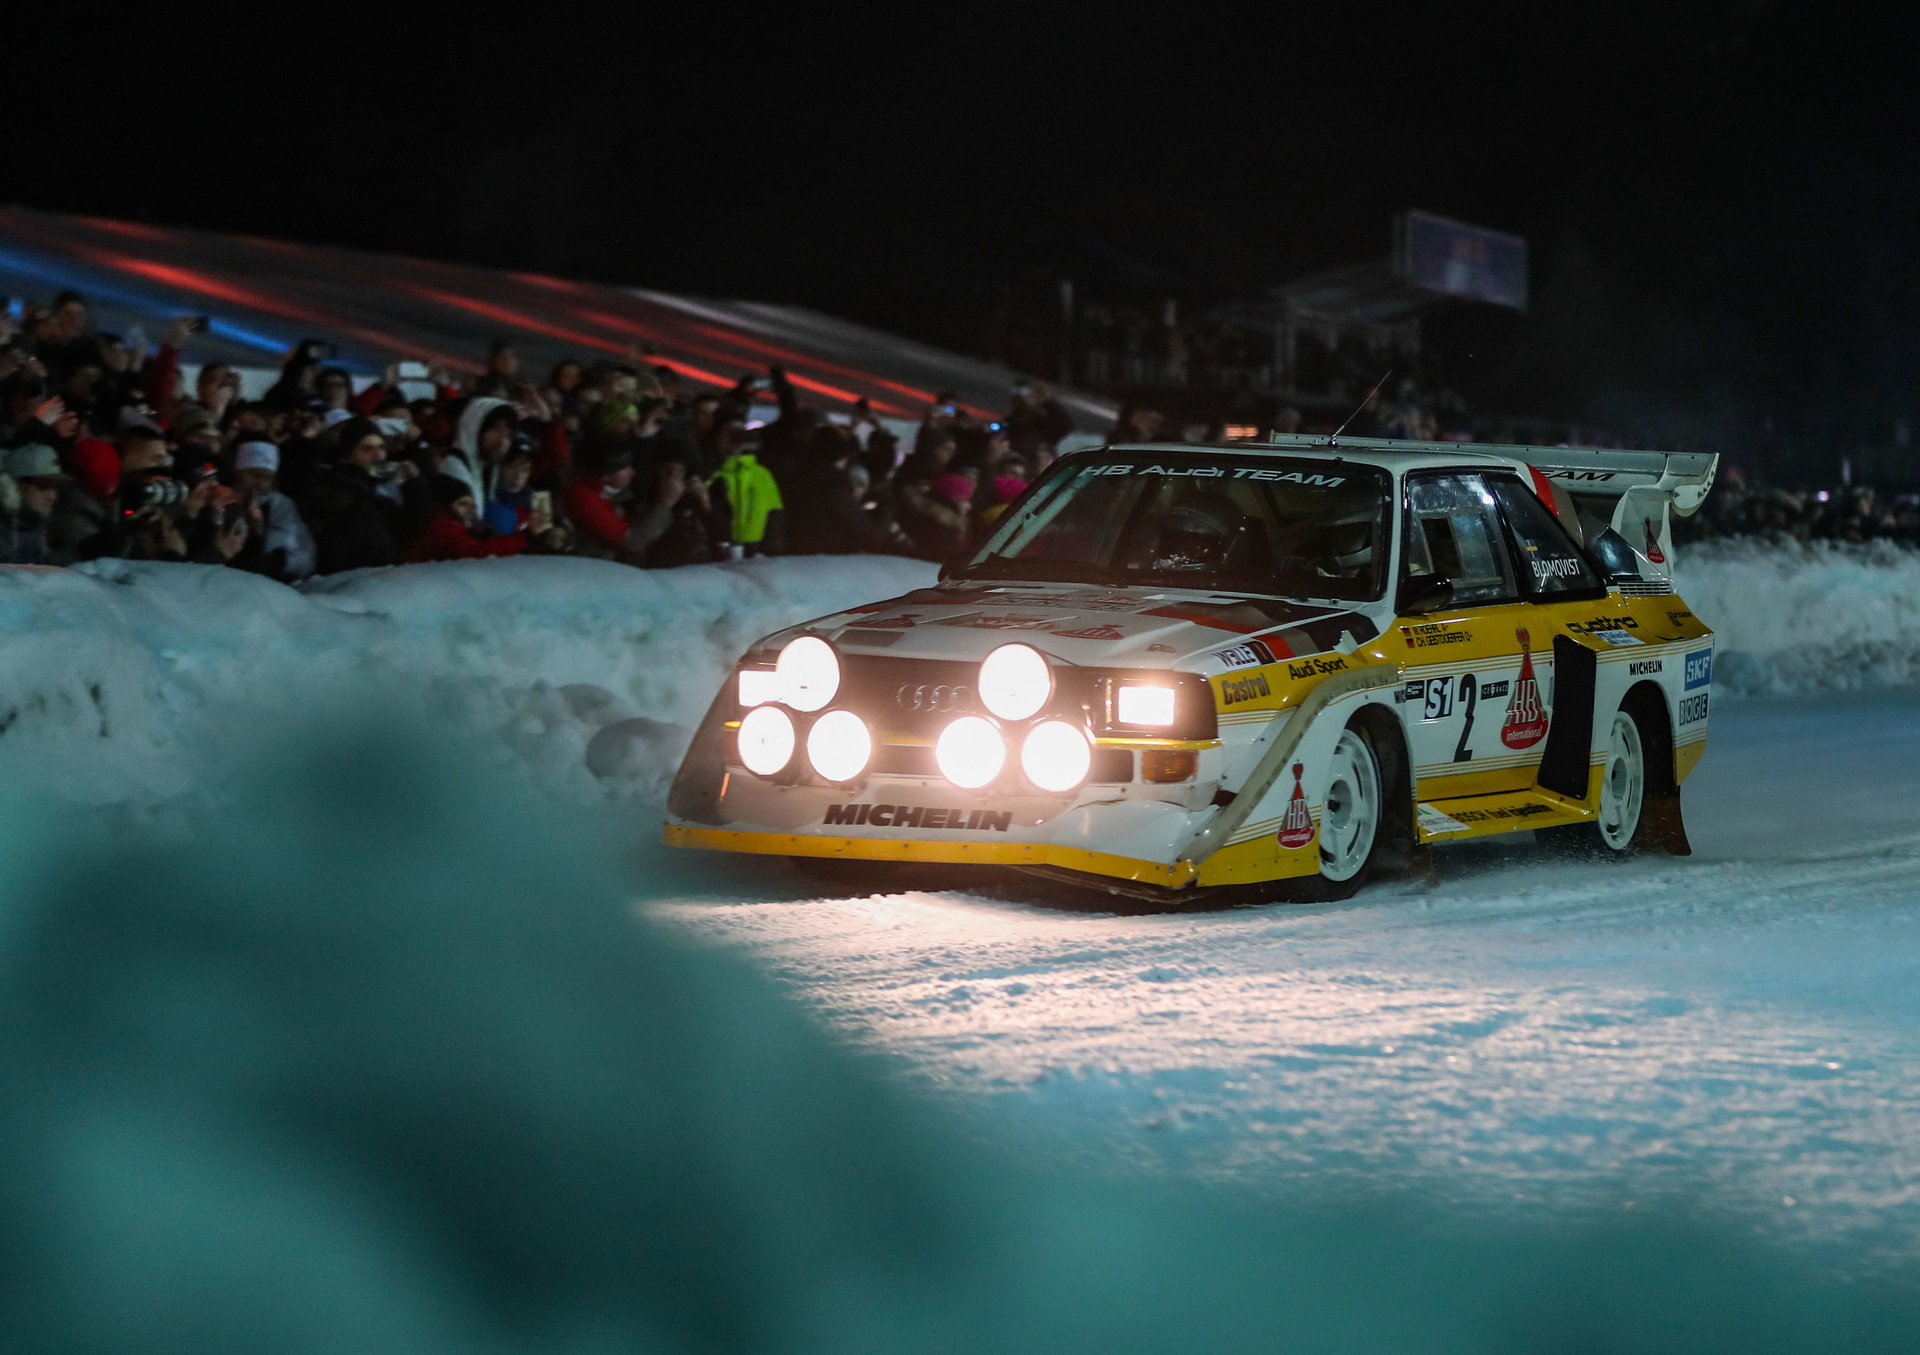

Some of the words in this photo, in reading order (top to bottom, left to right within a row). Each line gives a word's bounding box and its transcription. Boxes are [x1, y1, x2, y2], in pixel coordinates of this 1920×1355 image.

[1077, 464, 1135, 477] HB
[1138, 464, 1223, 478] Audi
[1232, 467, 1347, 488] TEAM
[1531, 558, 1581, 579] BLOMQVIST
[1565, 616, 1639, 636] quattro
[1213, 645, 1257, 667] WELLE
[1288, 661, 1316, 681] Audi
[1314, 657, 1349, 675] Sport
[1629, 660, 1663, 676] MICHELIN
[1686, 655, 1711, 683] SKF
[1221, 672, 1272, 706] Castrol
[1425, 677, 1453, 718] S1
[1513, 679, 1539, 725] HB
[1454, 673, 1477, 763] 2
[1679, 693, 1709, 726] BOGE
[1506, 725, 1543, 742] international
[823, 803, 1013, 832] MICHELIN
[1287, 799, 1306, 831] HB
